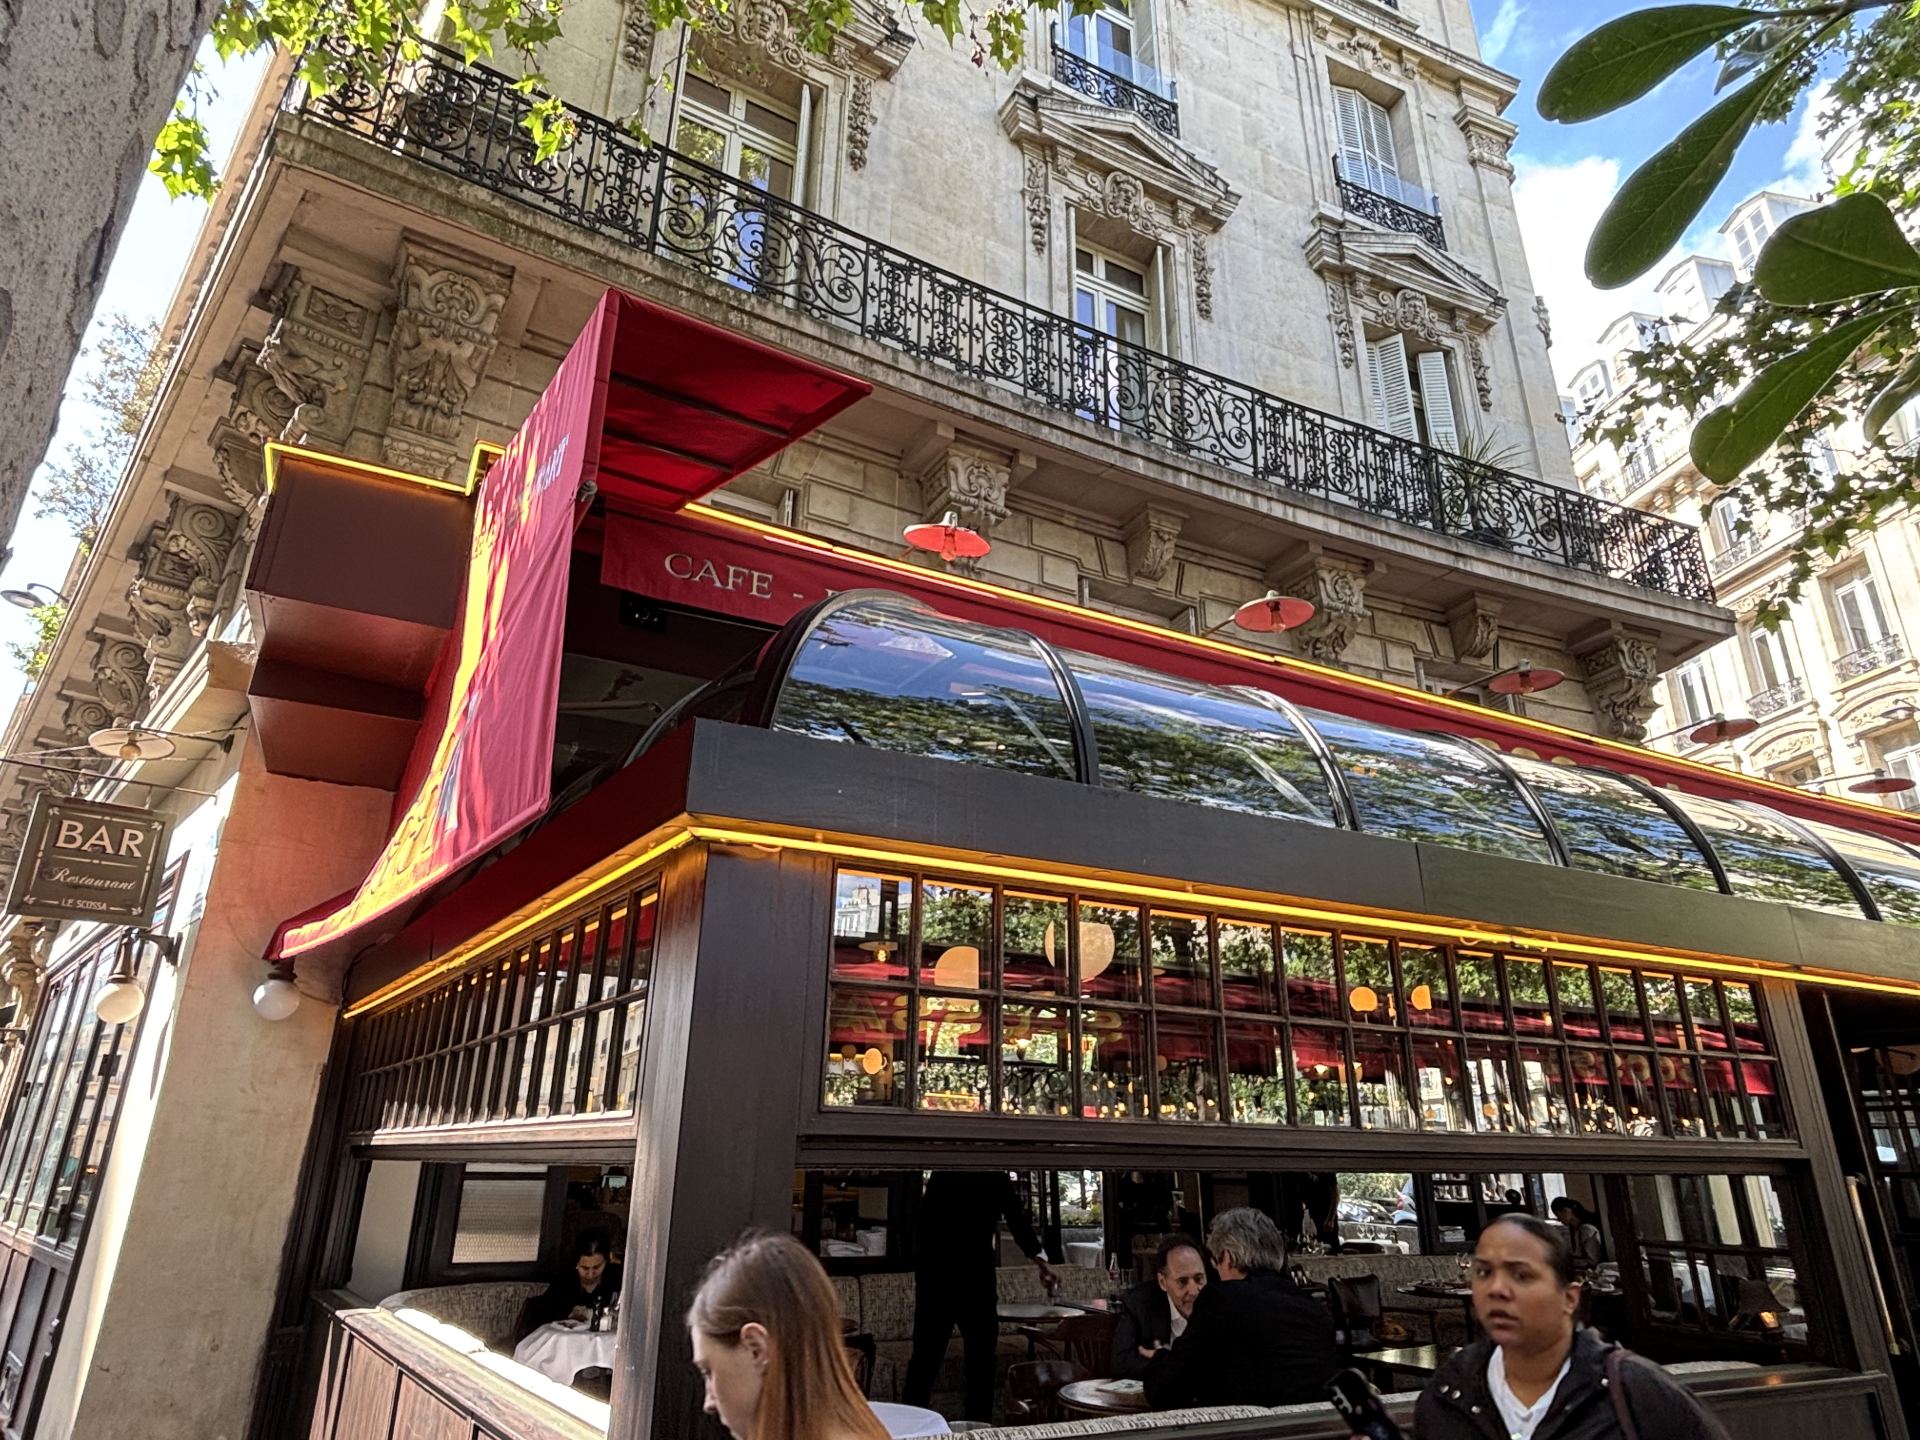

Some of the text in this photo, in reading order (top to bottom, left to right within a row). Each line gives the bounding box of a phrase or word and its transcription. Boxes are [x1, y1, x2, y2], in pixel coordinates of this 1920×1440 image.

[664, 552, 774, 599] CAFE
[55, 819, 145, 858] BAR
[48, 866, 136, 890] Restaurant
[61, 898, 108, 911] LE SCOSSA
